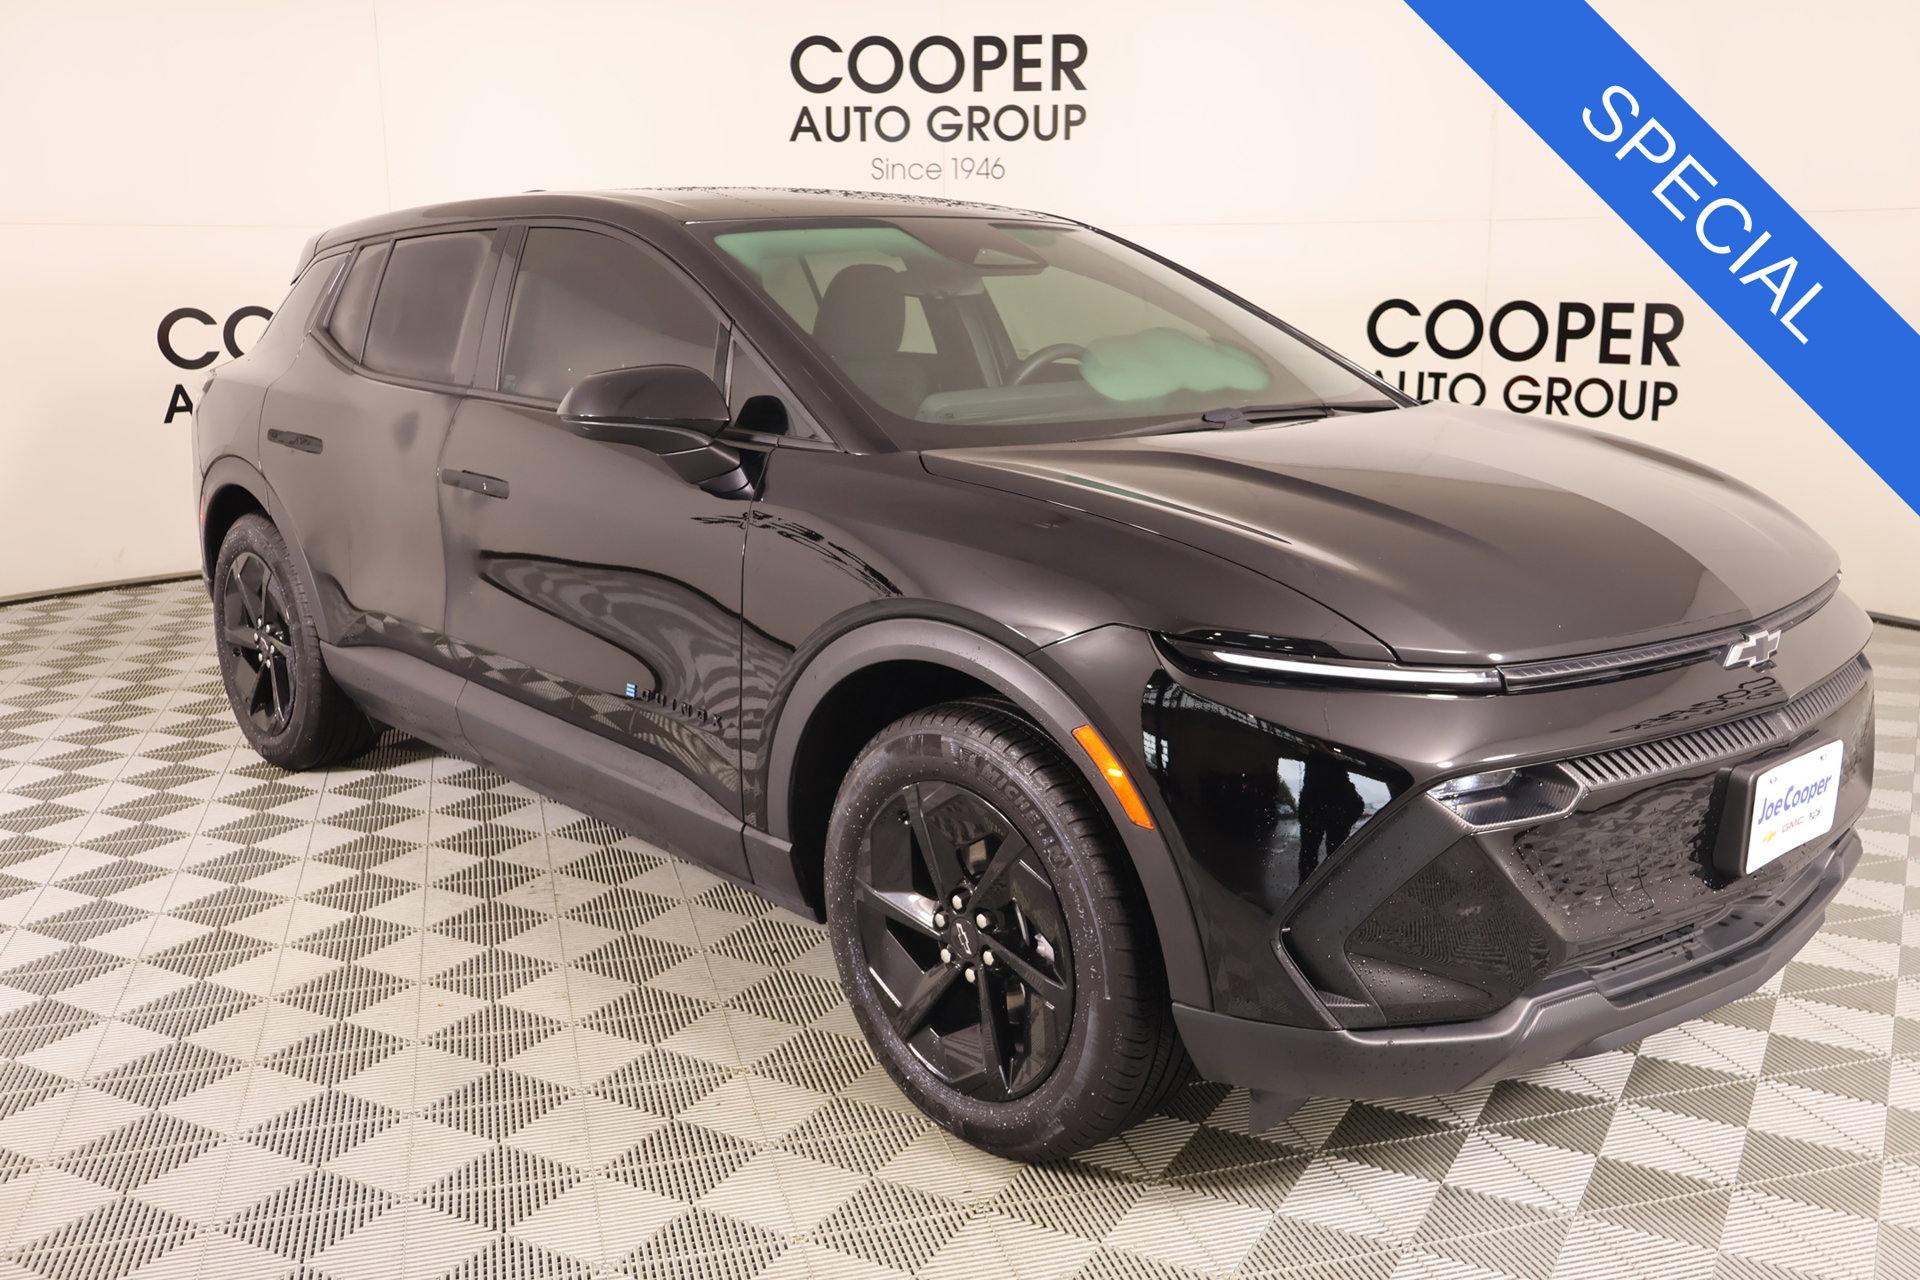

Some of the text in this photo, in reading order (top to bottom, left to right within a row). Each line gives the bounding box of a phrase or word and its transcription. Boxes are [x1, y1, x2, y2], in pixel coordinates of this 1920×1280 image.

[790, 34, 1088, 94] COOPER
[789, 103, 1087, 143] AUTO GROUP
[871, 156, 1006, 181] Since 1946
[1367, 298, 1685, 367] COOPER
[1503, 374, 1679, 421] GROUP
[981, 763, 1068, 871] MICHELIN
